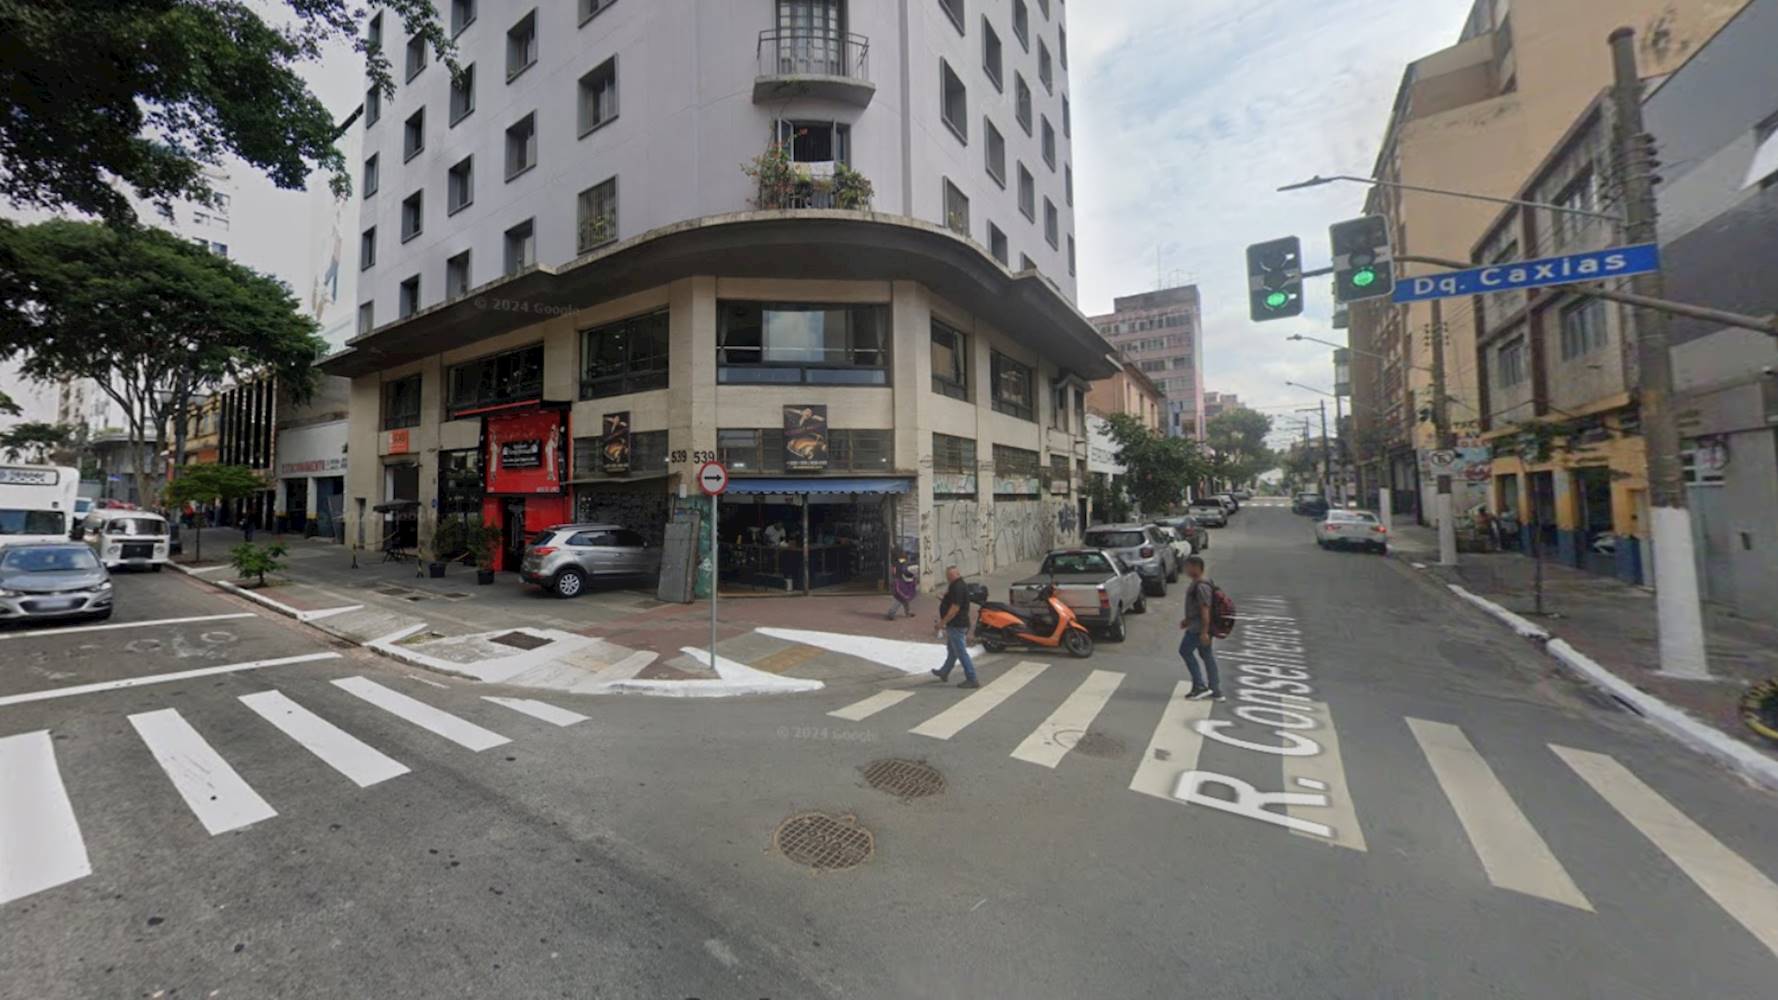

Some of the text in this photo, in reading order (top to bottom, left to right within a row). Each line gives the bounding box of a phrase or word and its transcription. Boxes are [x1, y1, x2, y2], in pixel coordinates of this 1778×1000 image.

[1414, 253, 1627, 295] Dq. Caxias
[672, 450, 687, 464] 539
[693, 450, 715, 464] 539
